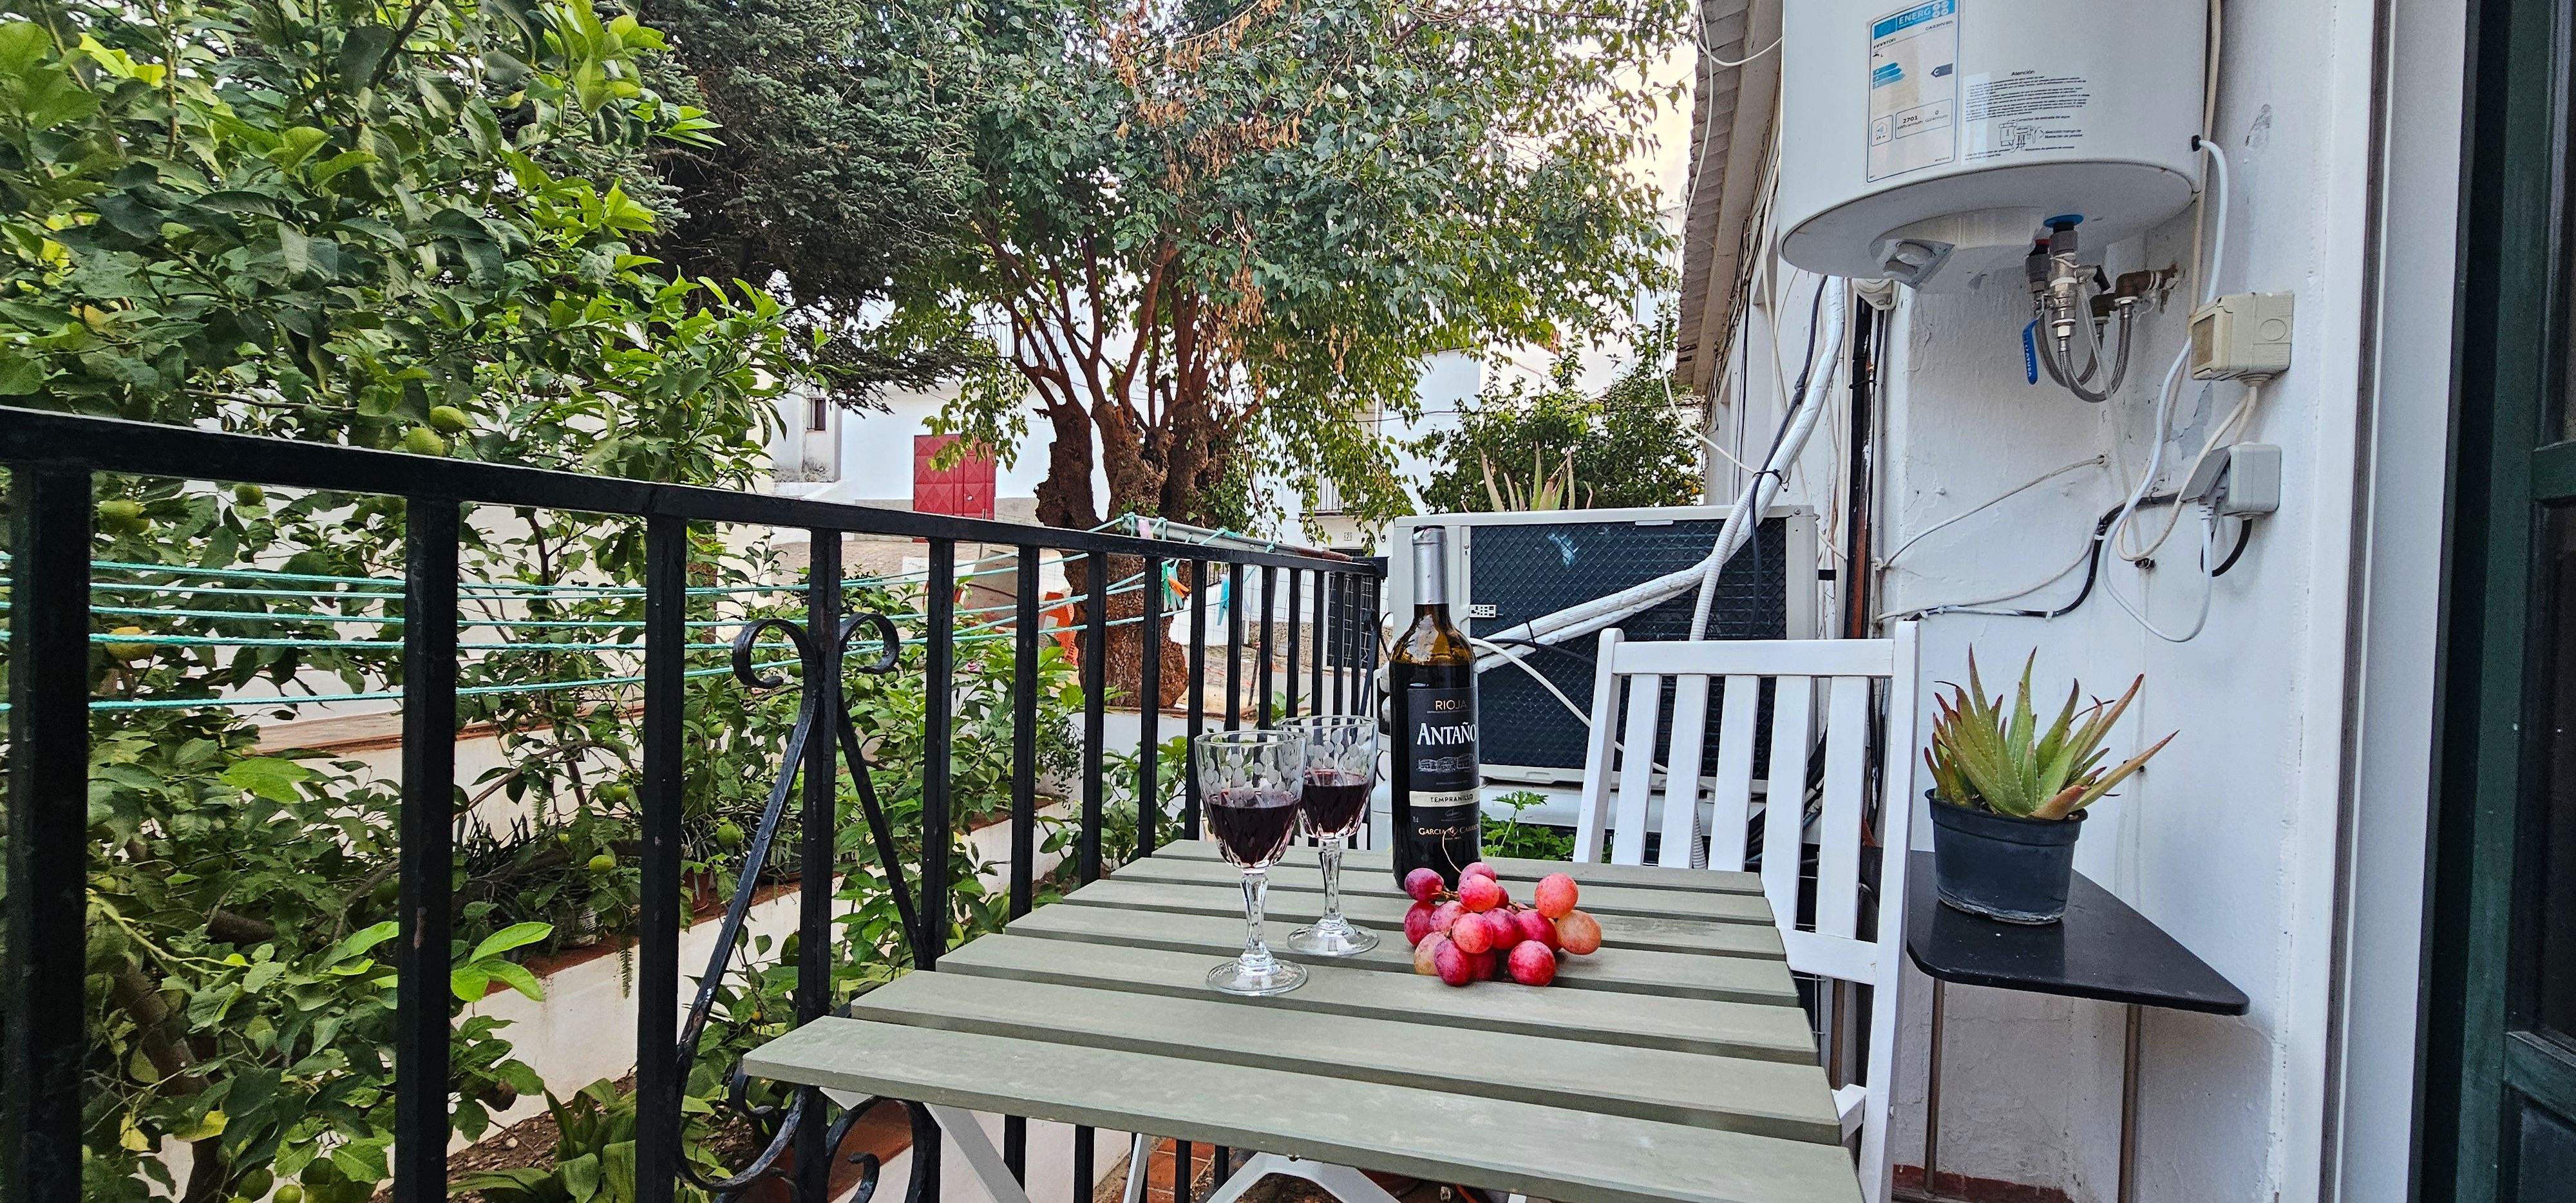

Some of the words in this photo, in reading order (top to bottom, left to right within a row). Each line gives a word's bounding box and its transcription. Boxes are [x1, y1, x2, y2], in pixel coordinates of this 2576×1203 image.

[1899, 7, 1931, 25] ENERG
[1435, 699, 1468, 710] RIOJA
[1417, 722, 1477, 745] ANTAÑO
[1430, 793, 1473, 803] TEMPRANILLO
